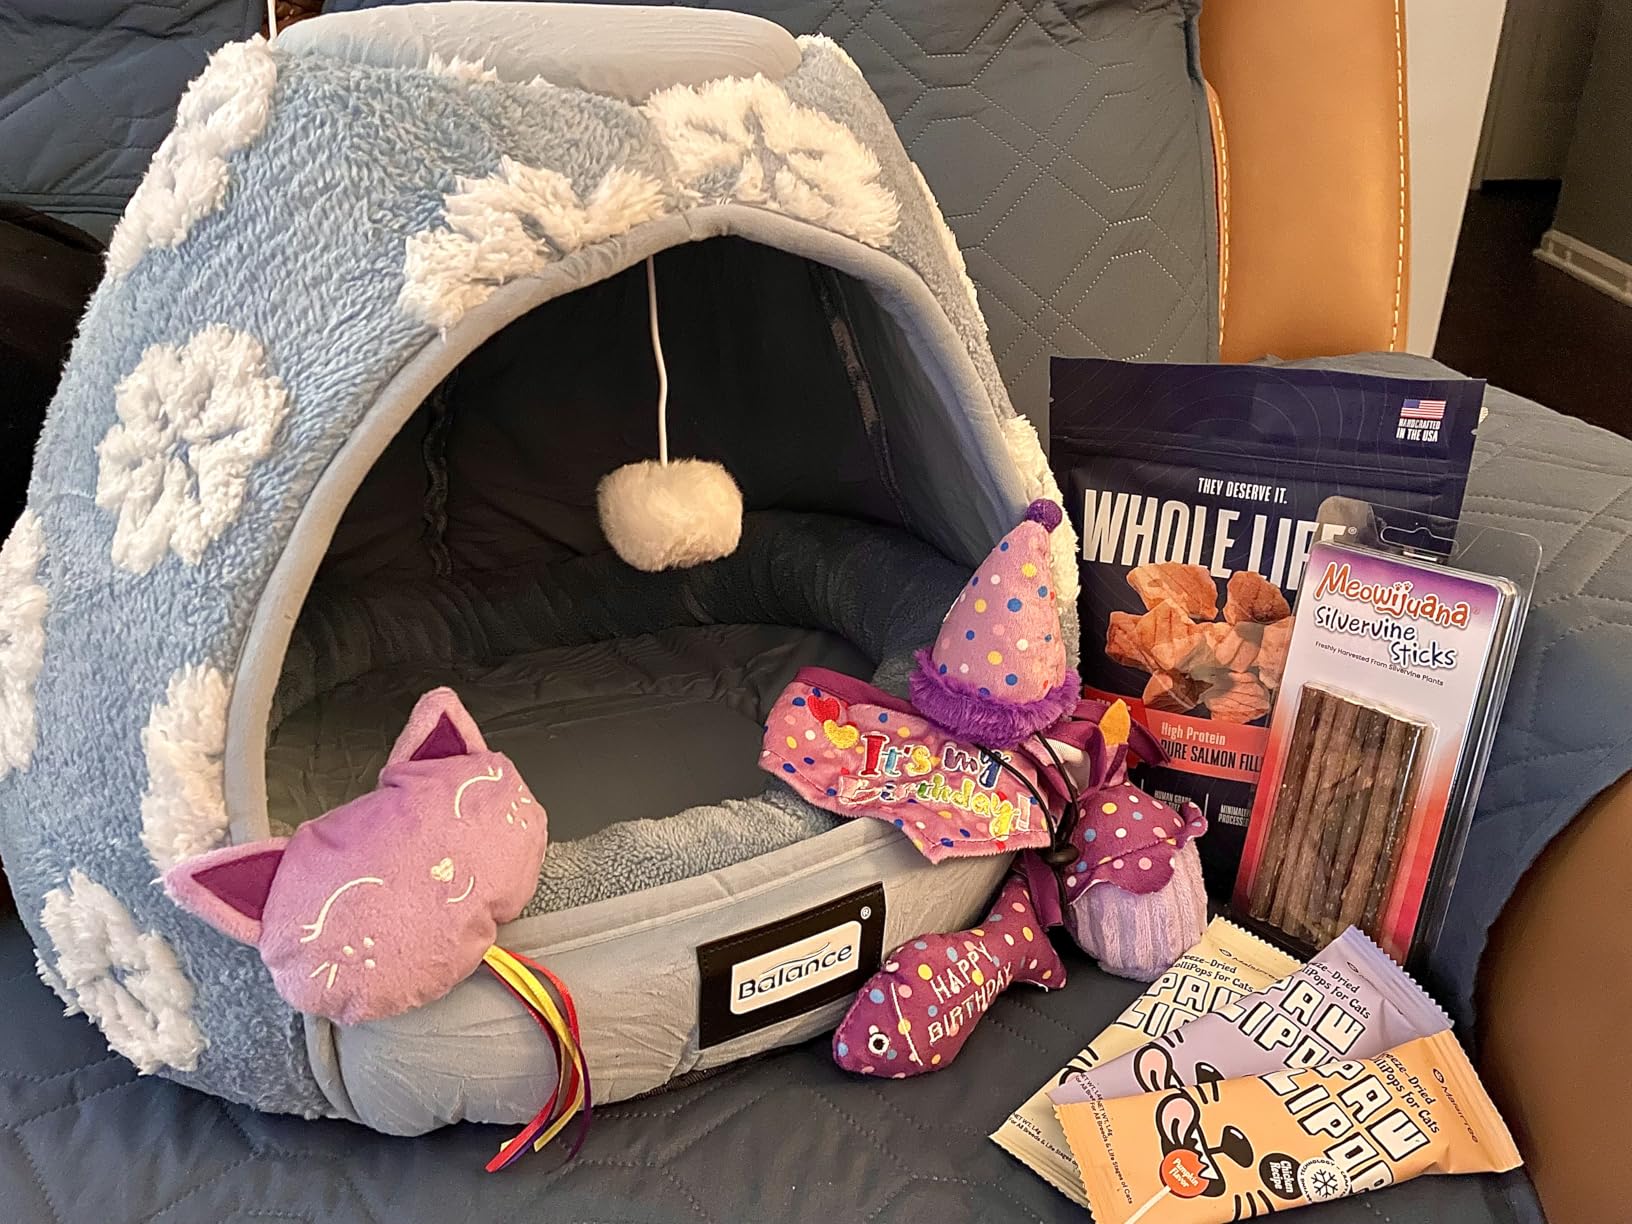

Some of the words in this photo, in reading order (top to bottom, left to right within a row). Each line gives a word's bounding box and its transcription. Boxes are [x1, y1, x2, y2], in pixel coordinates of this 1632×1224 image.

[1396, 427, 1406, 439] IN
[1407, 428, 1422, 441] THE
[1422, 429, 1439, 442] USA
[1398, 418, 1441, 430] HANDCRAFTED
[1198, 477, 1224, 496] THEY
[1225, 481, 1272, 502] DESERVE
[1274, 487, 1288, 504] IT.
[1082, 488, 1241, 579] WHOLE
[1314, 561, 1472, 628] Meowijuana
[1315, 604, 1417, 642] Silvervine
[1315, 641, 1337, 654] Freshly
[1338, 649, 1370, 663] Harvested
[1371, 659, 1388, 669] From
[1388, 664, 1421, 679] Silvervine
[1422, 674, 1444, 687] Plants
[1389, 640, 1457, 668] Sticks
[1161, 722, 1183, 740] High
[1187, 726, 1226, 746] Protein
[858, 731, 933, 777] It's
[943, 743, 1011, 790] my
[1190, 745, 1237, 769] SALMON
[1154, 790, 1173, 802] HUMAN
[738, 944, 852, 1001] Balance
[930, 940, 995, 1004] HAPPY
[1214, 973, 1230, 983] for
[1232, 978, 1255, 993] Cats
[927, 962, 1012, 1046] BIRTHDAY
[1331, 987, 1349, 1001] for
[1349, 998, 1371, 1019] Cats
[1097, 1101, 1105, 1111] NET
[1401, 1091, 1420, 1109] for
[1418, 1109, 1440, 1134] Cats
[1023, 1127, 1040, 1142] Breeds
[1045, 1142, 1055, 1151] Life
[1055, 1147, 1072, 1162] Stages
[1097, 1121, 1108, 1142] Breeds
[1113, 1160, 1123, 1180] Stages
[1124, 1189, 1133, 1204] Cats
[1169, 1167, 1190, 1188] Flavor
[1172, 1157, 1199, 1187] Pumpkin
[1269, 1161, 1283, 1190] Recipe
[1280, 1160, 1295, 1193] Chicken
